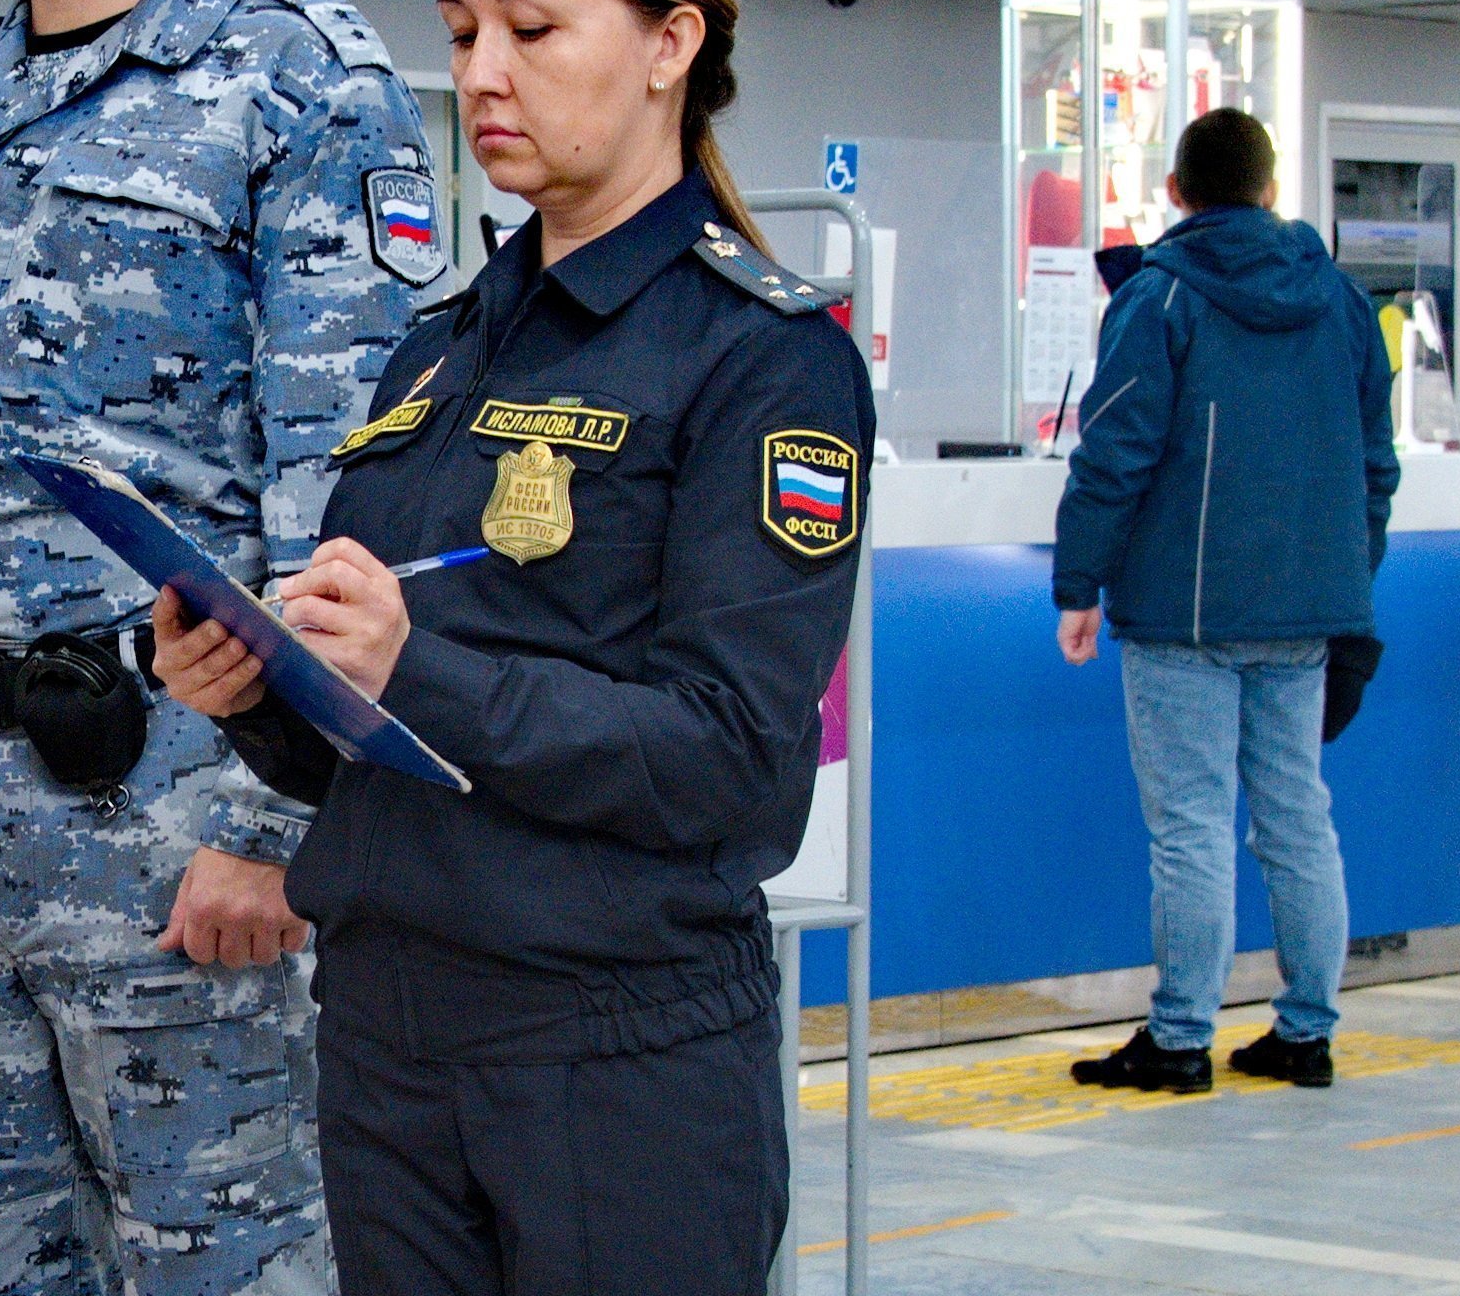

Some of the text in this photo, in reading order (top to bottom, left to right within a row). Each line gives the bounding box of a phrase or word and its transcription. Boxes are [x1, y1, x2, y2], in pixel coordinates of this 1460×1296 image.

[375, 179, 432, 205] РОССИЯ
[485, 408, 612, 442] ИСЛАМОВА Л.Р.
[772, 441, 851, 471] РОССИЯ
[514, 482, 548, 499] ФССП
[506, 495, 551, 515] РОССИИ
[519, 522, 556, 542] 13705
[784, 515, 839, 541] ФССП
